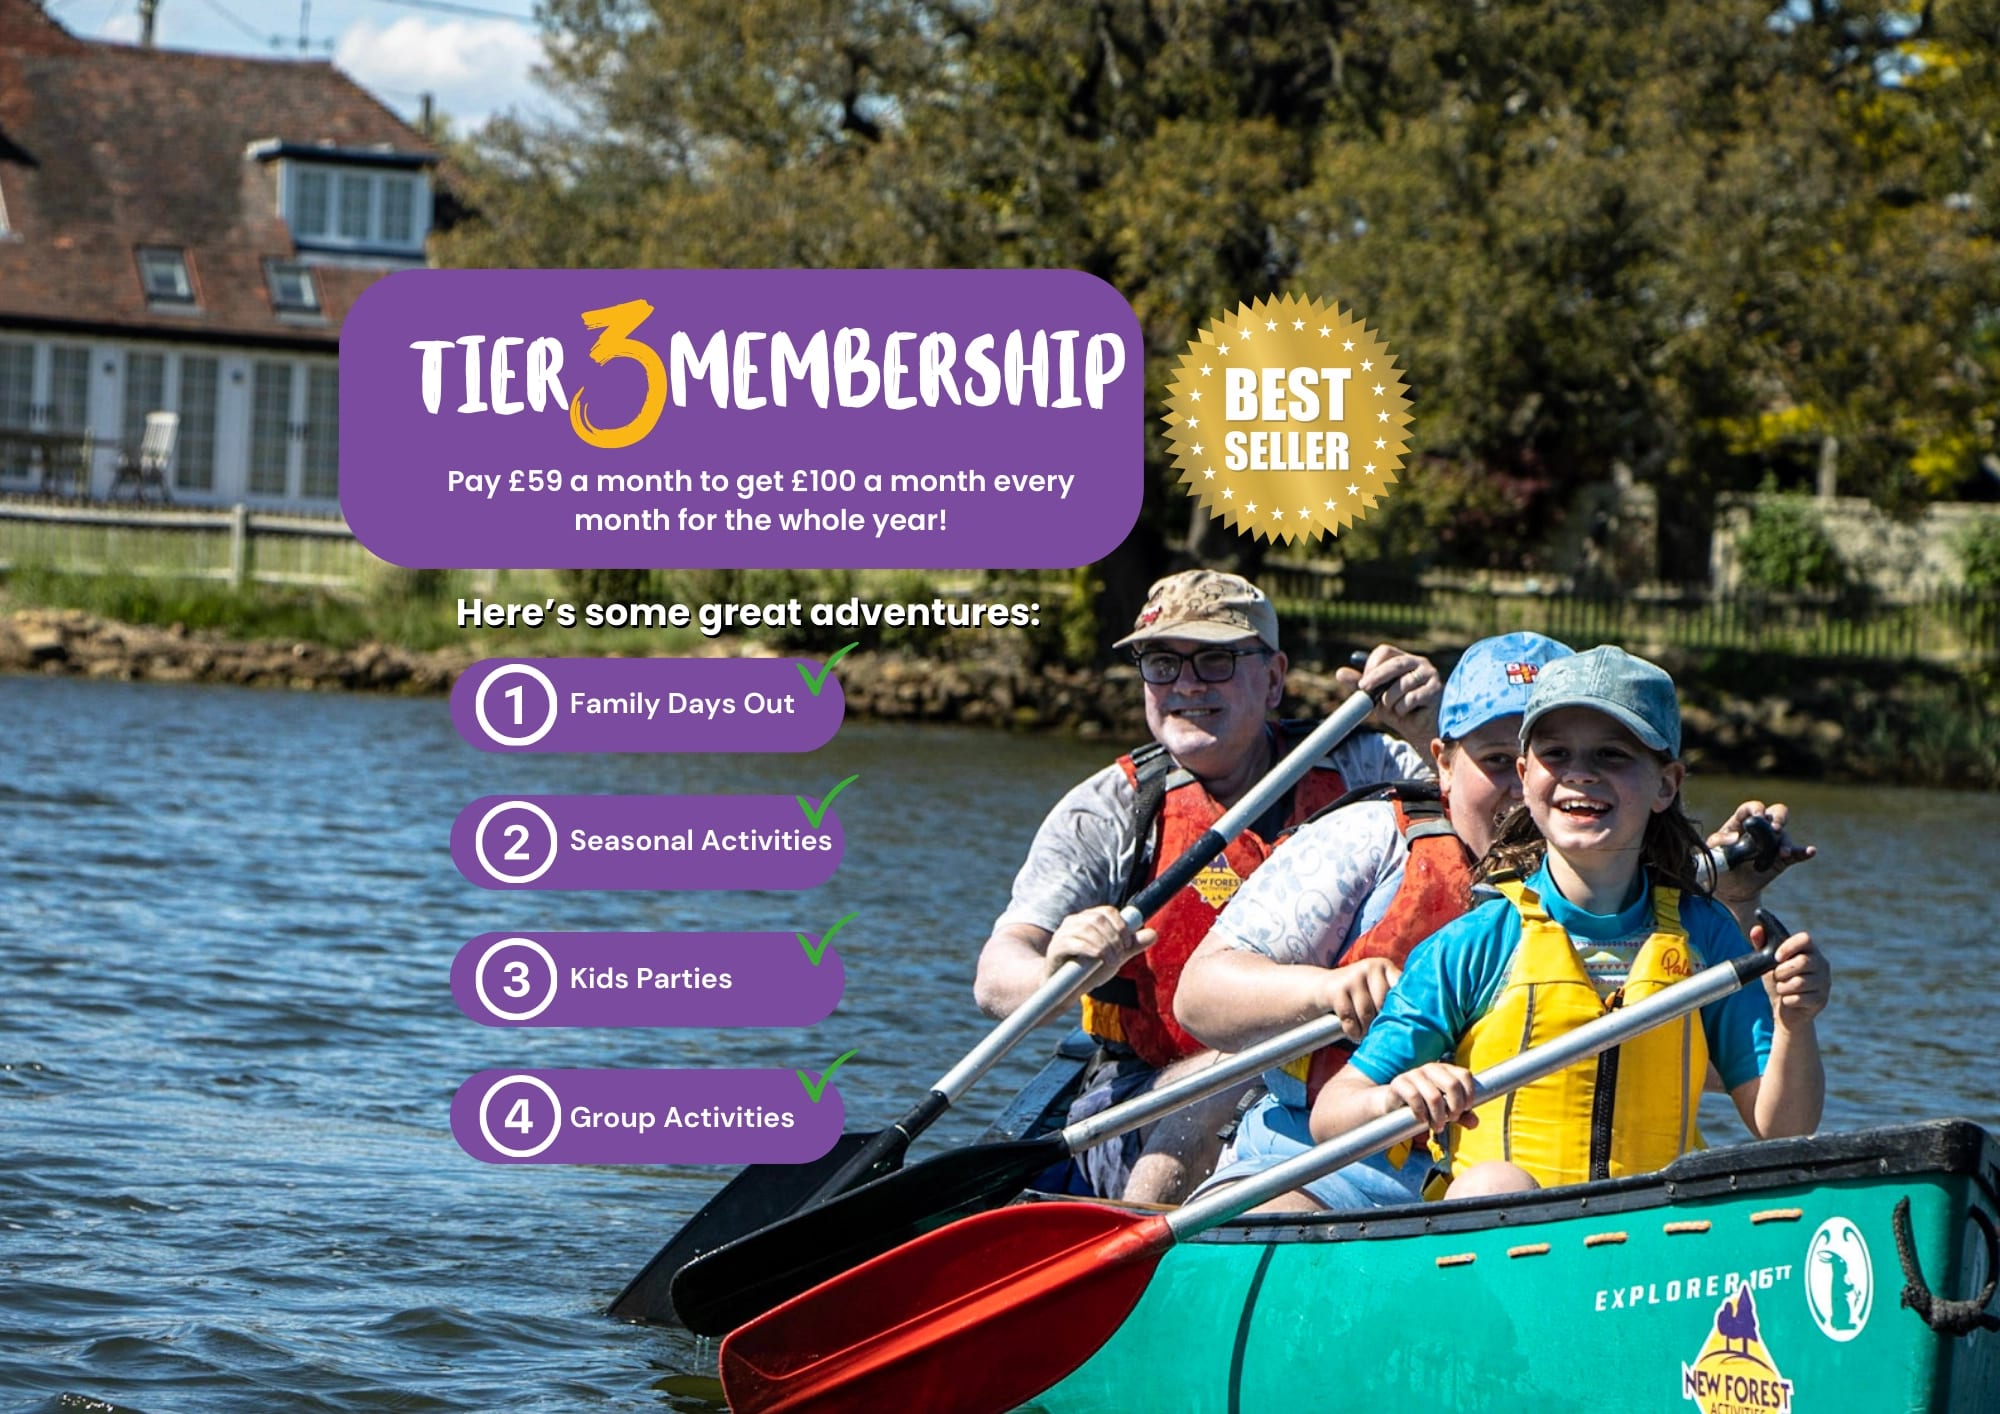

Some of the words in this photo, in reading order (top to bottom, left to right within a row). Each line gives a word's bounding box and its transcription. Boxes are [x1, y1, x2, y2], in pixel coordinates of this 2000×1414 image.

[1595, 1271, 1739, 1312] EXPLORER
[1685, 1370, 1721, 1397] NEW
[1725, 1374, 1790, 1409] FOREST
